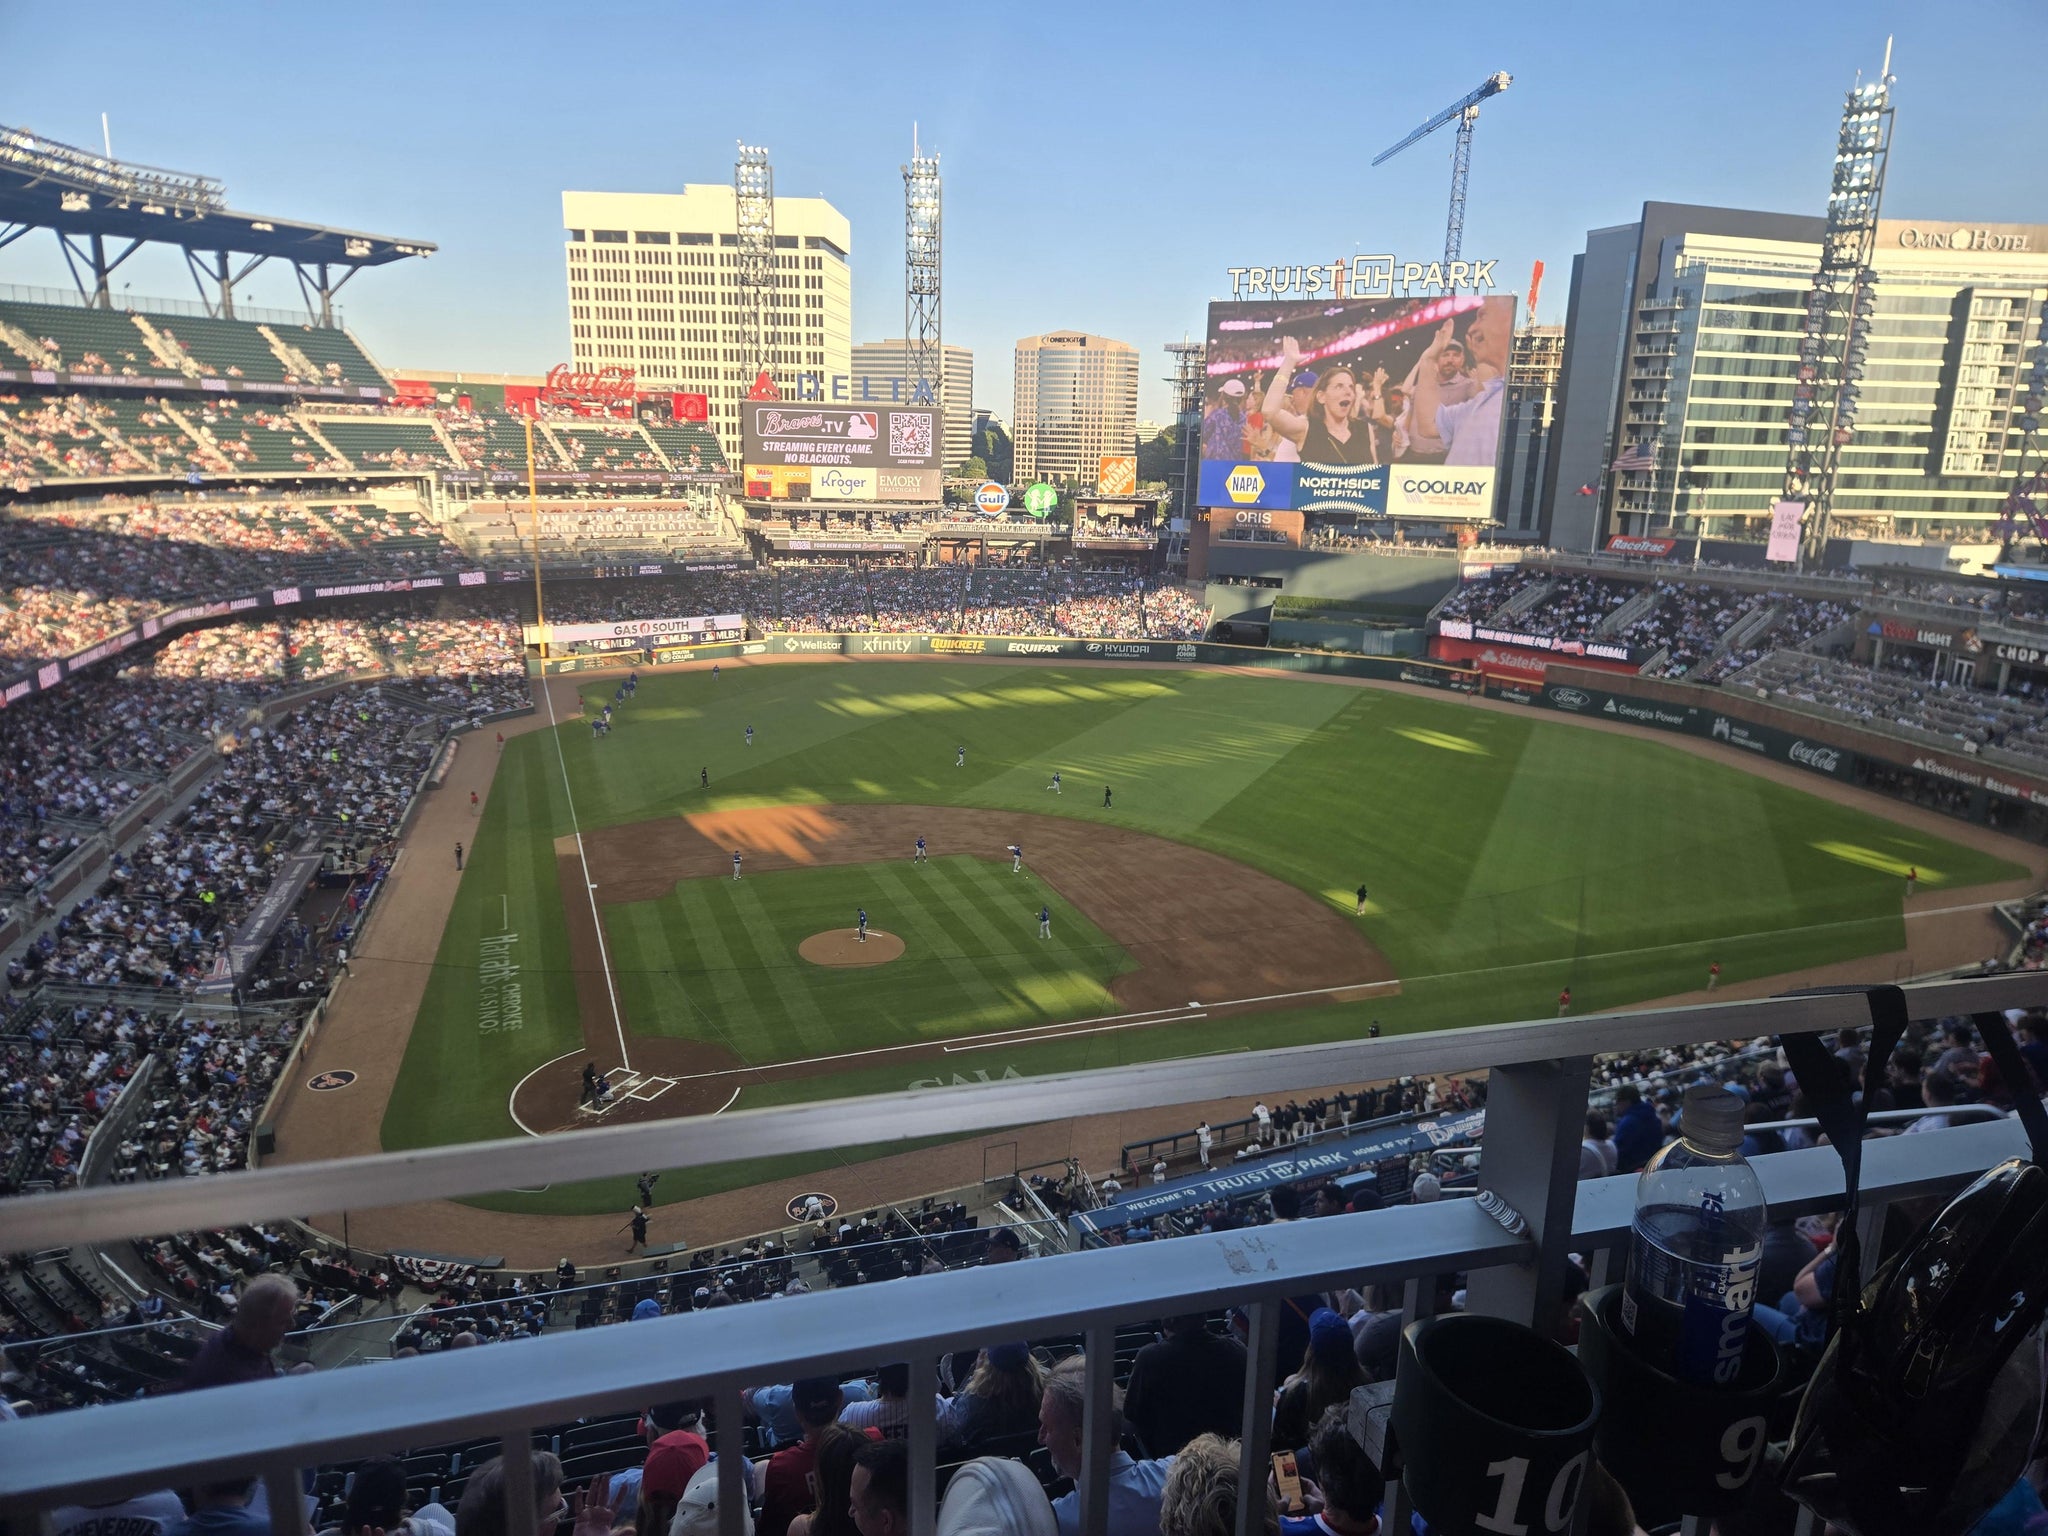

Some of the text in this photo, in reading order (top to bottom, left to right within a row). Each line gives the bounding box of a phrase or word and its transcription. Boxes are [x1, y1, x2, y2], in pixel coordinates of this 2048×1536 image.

[1228, 260, 1499, 294] TRUIST PARK
[797, 373, 935, 402] DELTA
[763, 442, 873, 454] STREAMING EVERY GAME.
[784, 454, 852, 465] NO BLACKOUTS.
[821, 470, 867, 495] Kroger
[879, 476, 922, 487] EMORY
[1099, 457, 1136, 494] HOME
[1300, 477, 1381, 490] NORTHSIDE
[1232, 476, 1258, 492] NAPA
[1404, 480, 1487, 495] COOLRAY
[978, 493, 1006, 504] Gulf
[1313, 489, 1365, 498] HOSPITAL
[1236, 511, 1272, 524] ORIS
[1611, 539, 1666, 553] RaceTrac
[315, 587, 333, 597] YOUR
[334, 586, 350, 596] NEW
[350, 585, 371, 594] HOME
[371, 583, 384, 592] FOR
[413, 578, 443, 587] BASEBALL
[614, 621, 689, 635] GAS SOUTH
[716, 630, 739, 639] MLB+
[610, 639, 636, 648] MLB+
[669, 635, 693, 644] MLB+
[800, 640, 842, 650] Wellstar
[863, 636, 912, 652] xfinity
[930, 638, 985, 650] QUIKRETE
[1475, 629, 1494, 640] YOUR
[1495, 631, 1512, 643] NEW
[1512, 633, 1535, 646] HOME
[1535, 637, 1551, 649] FOR
[1586, 644, 1628, 660] BASEBALL
[1917, 629, 1952, 647] LIGHT
[1008, 642, 1059, 654] EQUIFAX
[1105, 644, 1149, 653] HYUNDAI
[1177, 644, 1196, 652] PAPA
[1996, 645, 2039, 663] CHOP
[1498, 652, 1547, 672] State Far
[1556, 688, 1583, 705] Ford
[1619, 703, 1653, 720] Georgia
[1656, 711, 1684, 725] Power
[479, 985, 500, 1035] CASINOS
[502, 982, 523, 1032] CHEROKEE
[1127, 1195, 1182, 1213] WELCOME
[1203, 1168, 1271, 1195] TRUIST
[1297, 1151, 1351, 1176] PARK
[1352, 1145, 1382, 1157] HOME
[1714, 1243, 1761, 1383] smart
[1714, 1416, 1766, 1490] 9
[1474, 1451, 1588, 1536] 10
